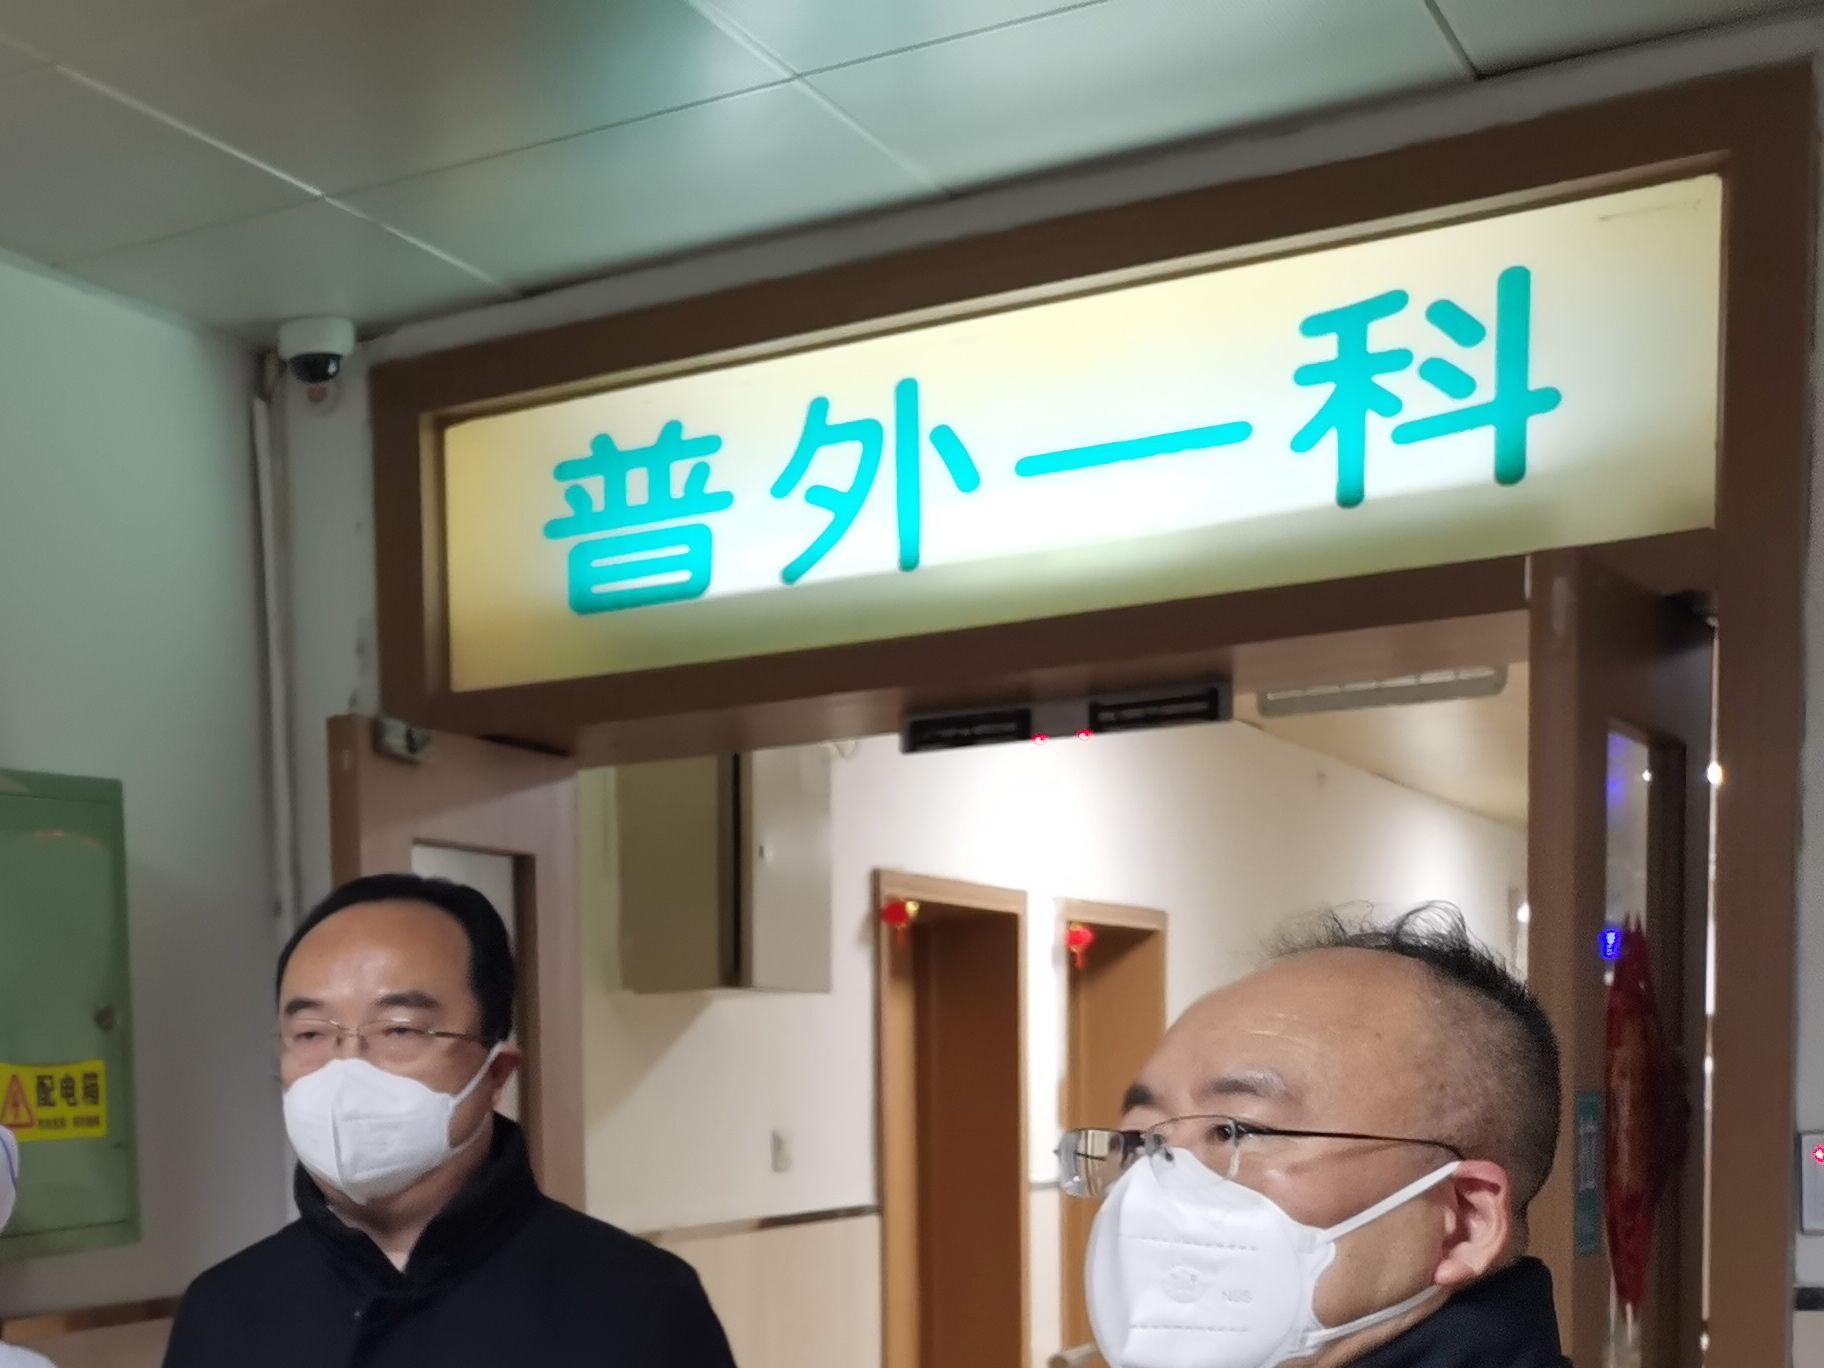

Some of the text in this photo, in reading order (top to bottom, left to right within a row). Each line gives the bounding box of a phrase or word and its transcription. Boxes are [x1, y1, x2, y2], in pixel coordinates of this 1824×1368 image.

[542, 265, 1562, 616] 普外一科
[37, 1072, 100, 1107] 配电箱
